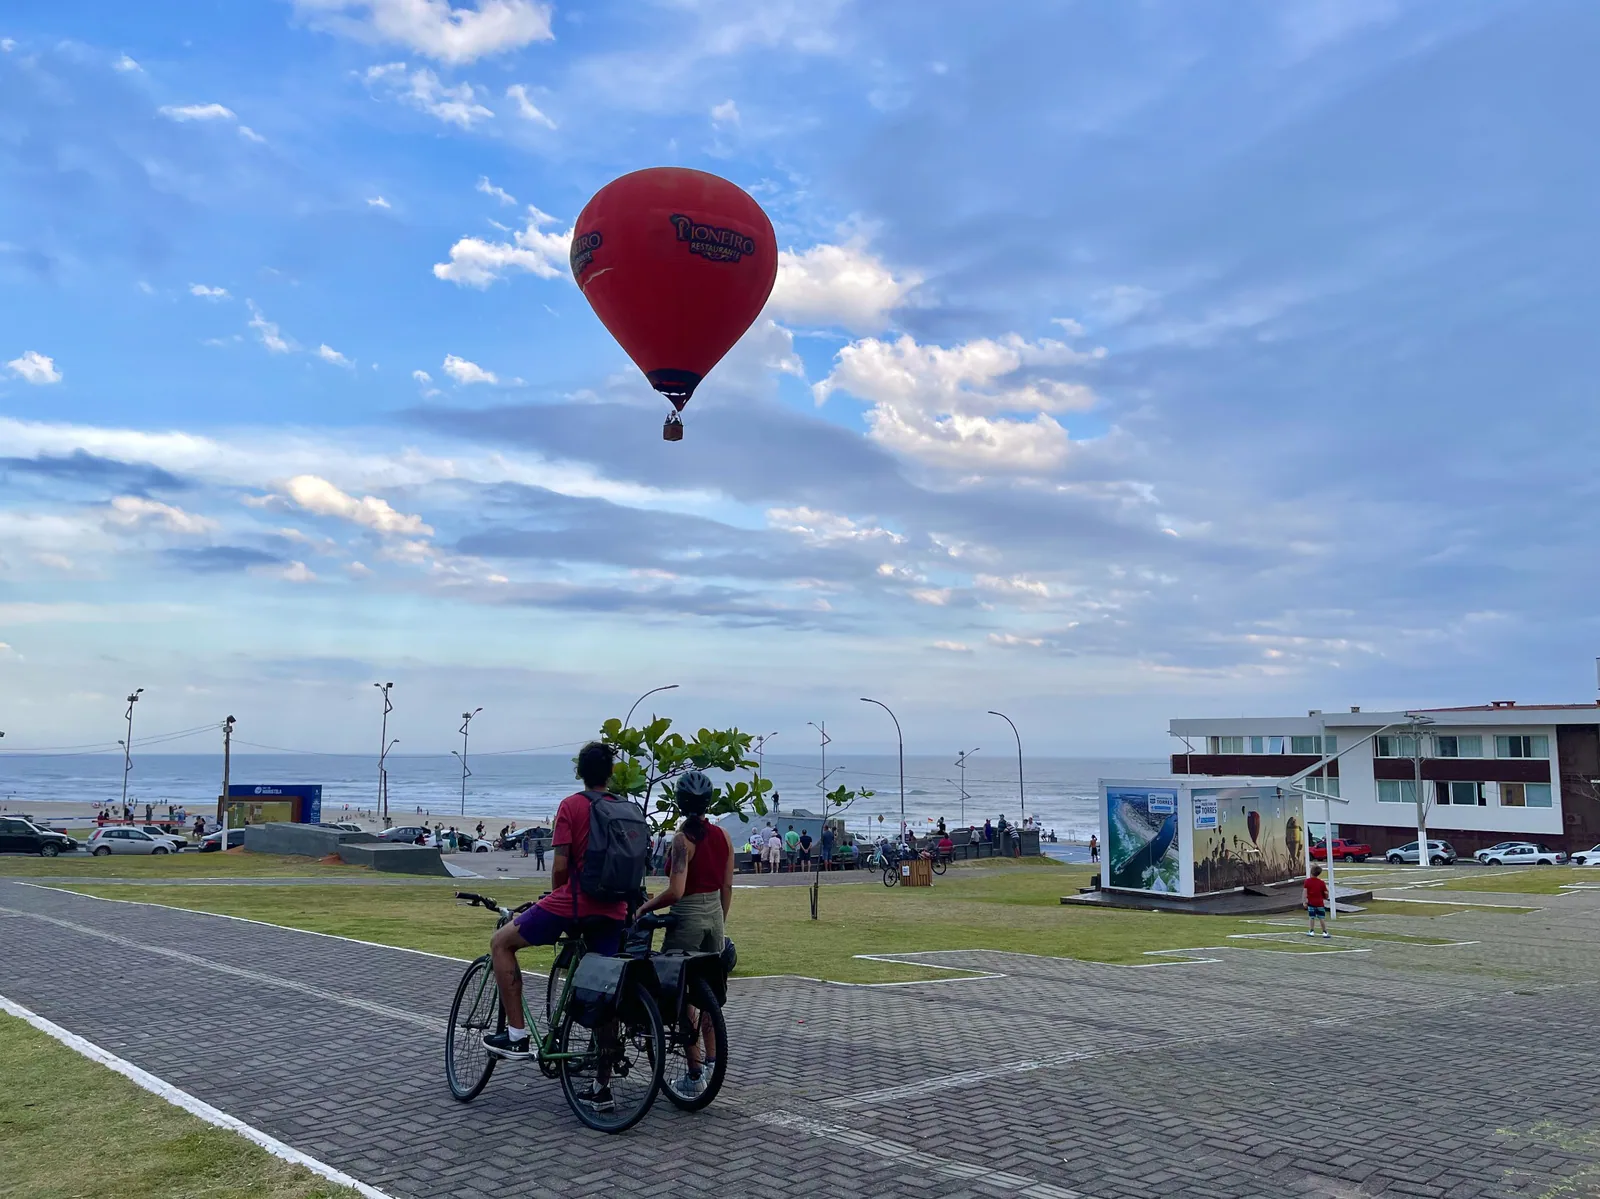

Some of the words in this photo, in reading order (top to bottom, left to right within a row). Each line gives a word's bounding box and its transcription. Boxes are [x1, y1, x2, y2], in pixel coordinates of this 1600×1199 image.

[673, 216, 754, 253] PIONEIRO
[691, 242, 741, 258] RESTAURANTE
[1201, 806, 1217, 815] TORRES
